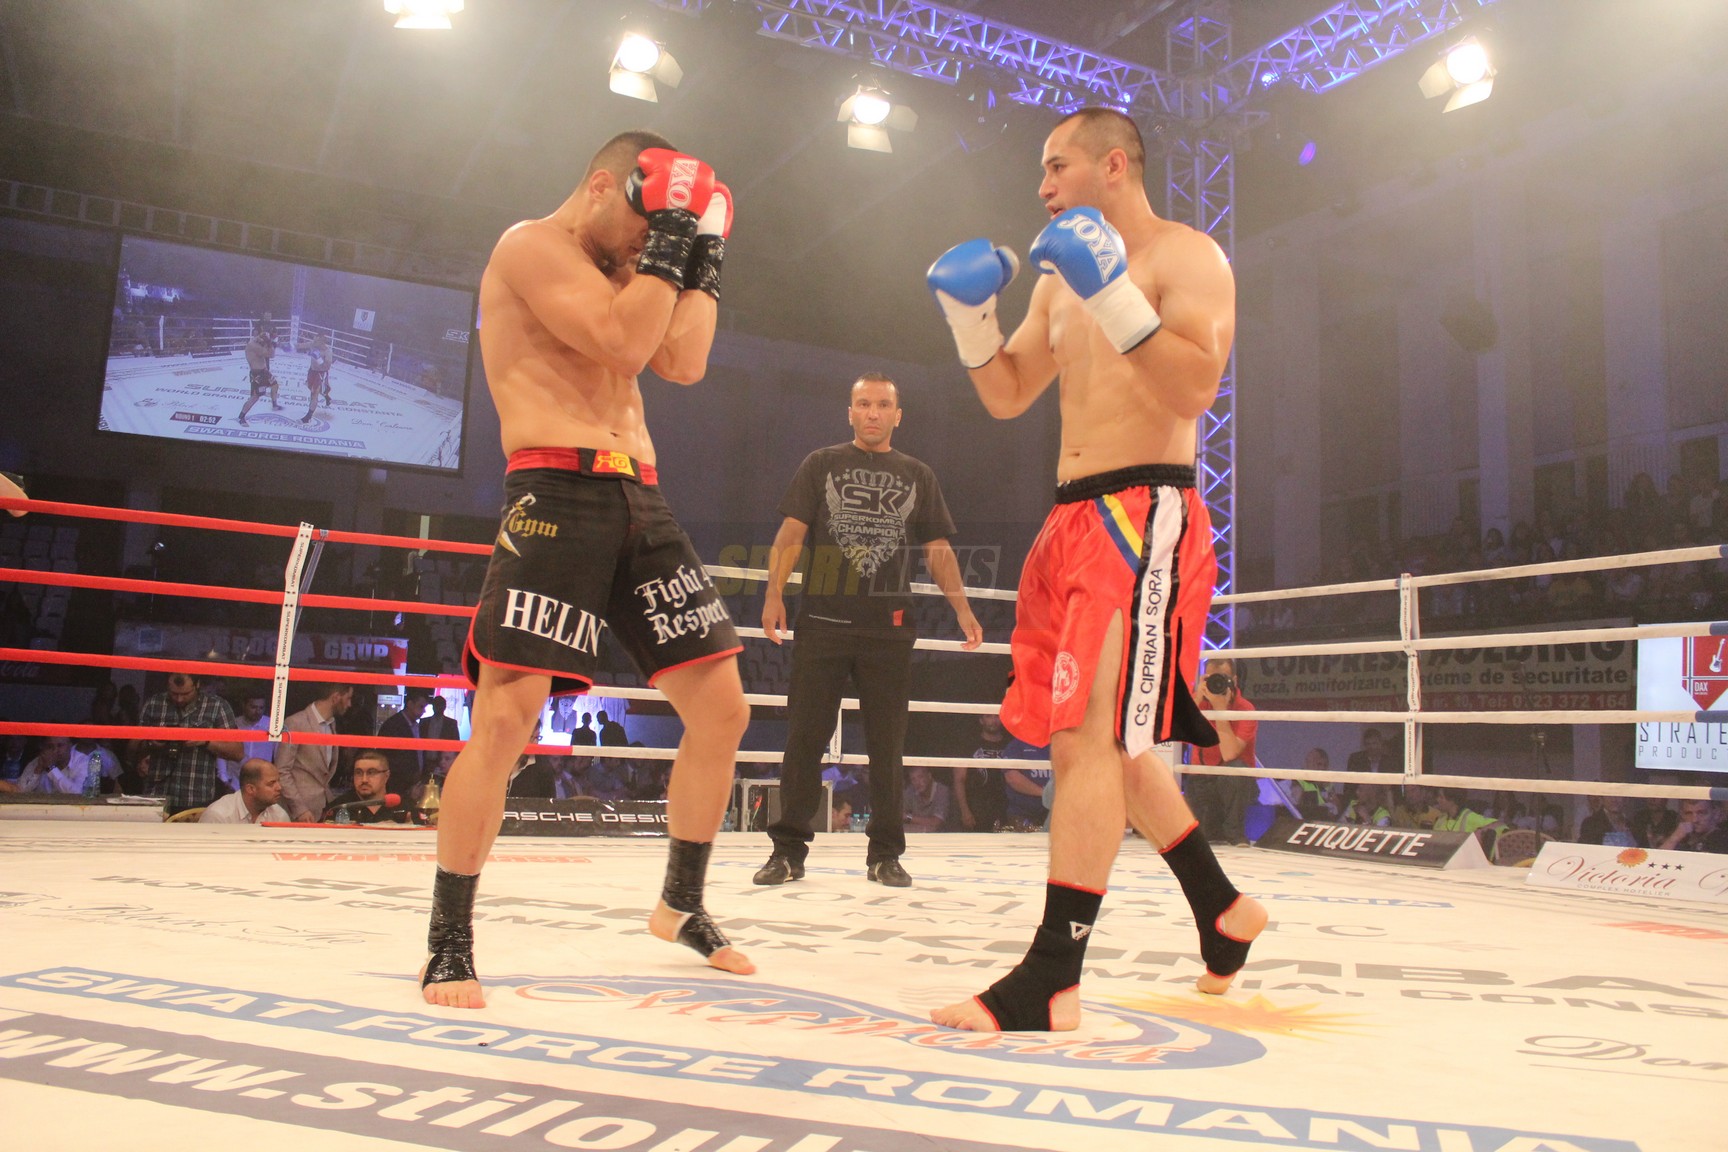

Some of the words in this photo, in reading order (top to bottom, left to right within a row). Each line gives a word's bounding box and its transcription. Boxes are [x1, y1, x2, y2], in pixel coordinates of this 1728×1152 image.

[667, 158, 699, 209] OYA
[1057, 214, 1119, 283] JOYA
[188, 426, 236, 437] SWAT
[238, 431, 289, 441] FORCE
[293, 435, 364, 448] ROMANIA
[842, 484, 903, 517] SK
[508, 511, 558, 538] Gym
[837, 522, 899, 538] CHAMPION
[634, 565, 703, 615] Fight
[1146, 568, 1163, 616] SORA
[324, 642, 389, 661] GRUP
[1140, 624, 1157, 694] CIPRIAN
[1404, 670, 1472, 688] ssteme
[1480, 668, 1505, 685] de
[1511, 666, 1629, 686] securitate
[1694, 682, 1709, 692] DAX
[1134, 703, 1150, 726] CS
[1638, 745, 1728, 760] PRODUC
[502, 811, 594, 822] RSCHE
[601, 813, 669, 823] DESI
[1287, 822, 1432, 857] ETIQUETTE
[1546, 855, 1677, 890] Victoria
[91, 875, 330, 902] WORLD
[335, 900, 607, 930] GRND
[906, 953, 1365, 997] MMAIA,
[842, 911, 1113, 936] MAMAA
[15, 971, 345, 1020] SWAT
[335, 1014, 780, 1081] FORCE
[803, 1068, 1595, 1152] ROMANIA
